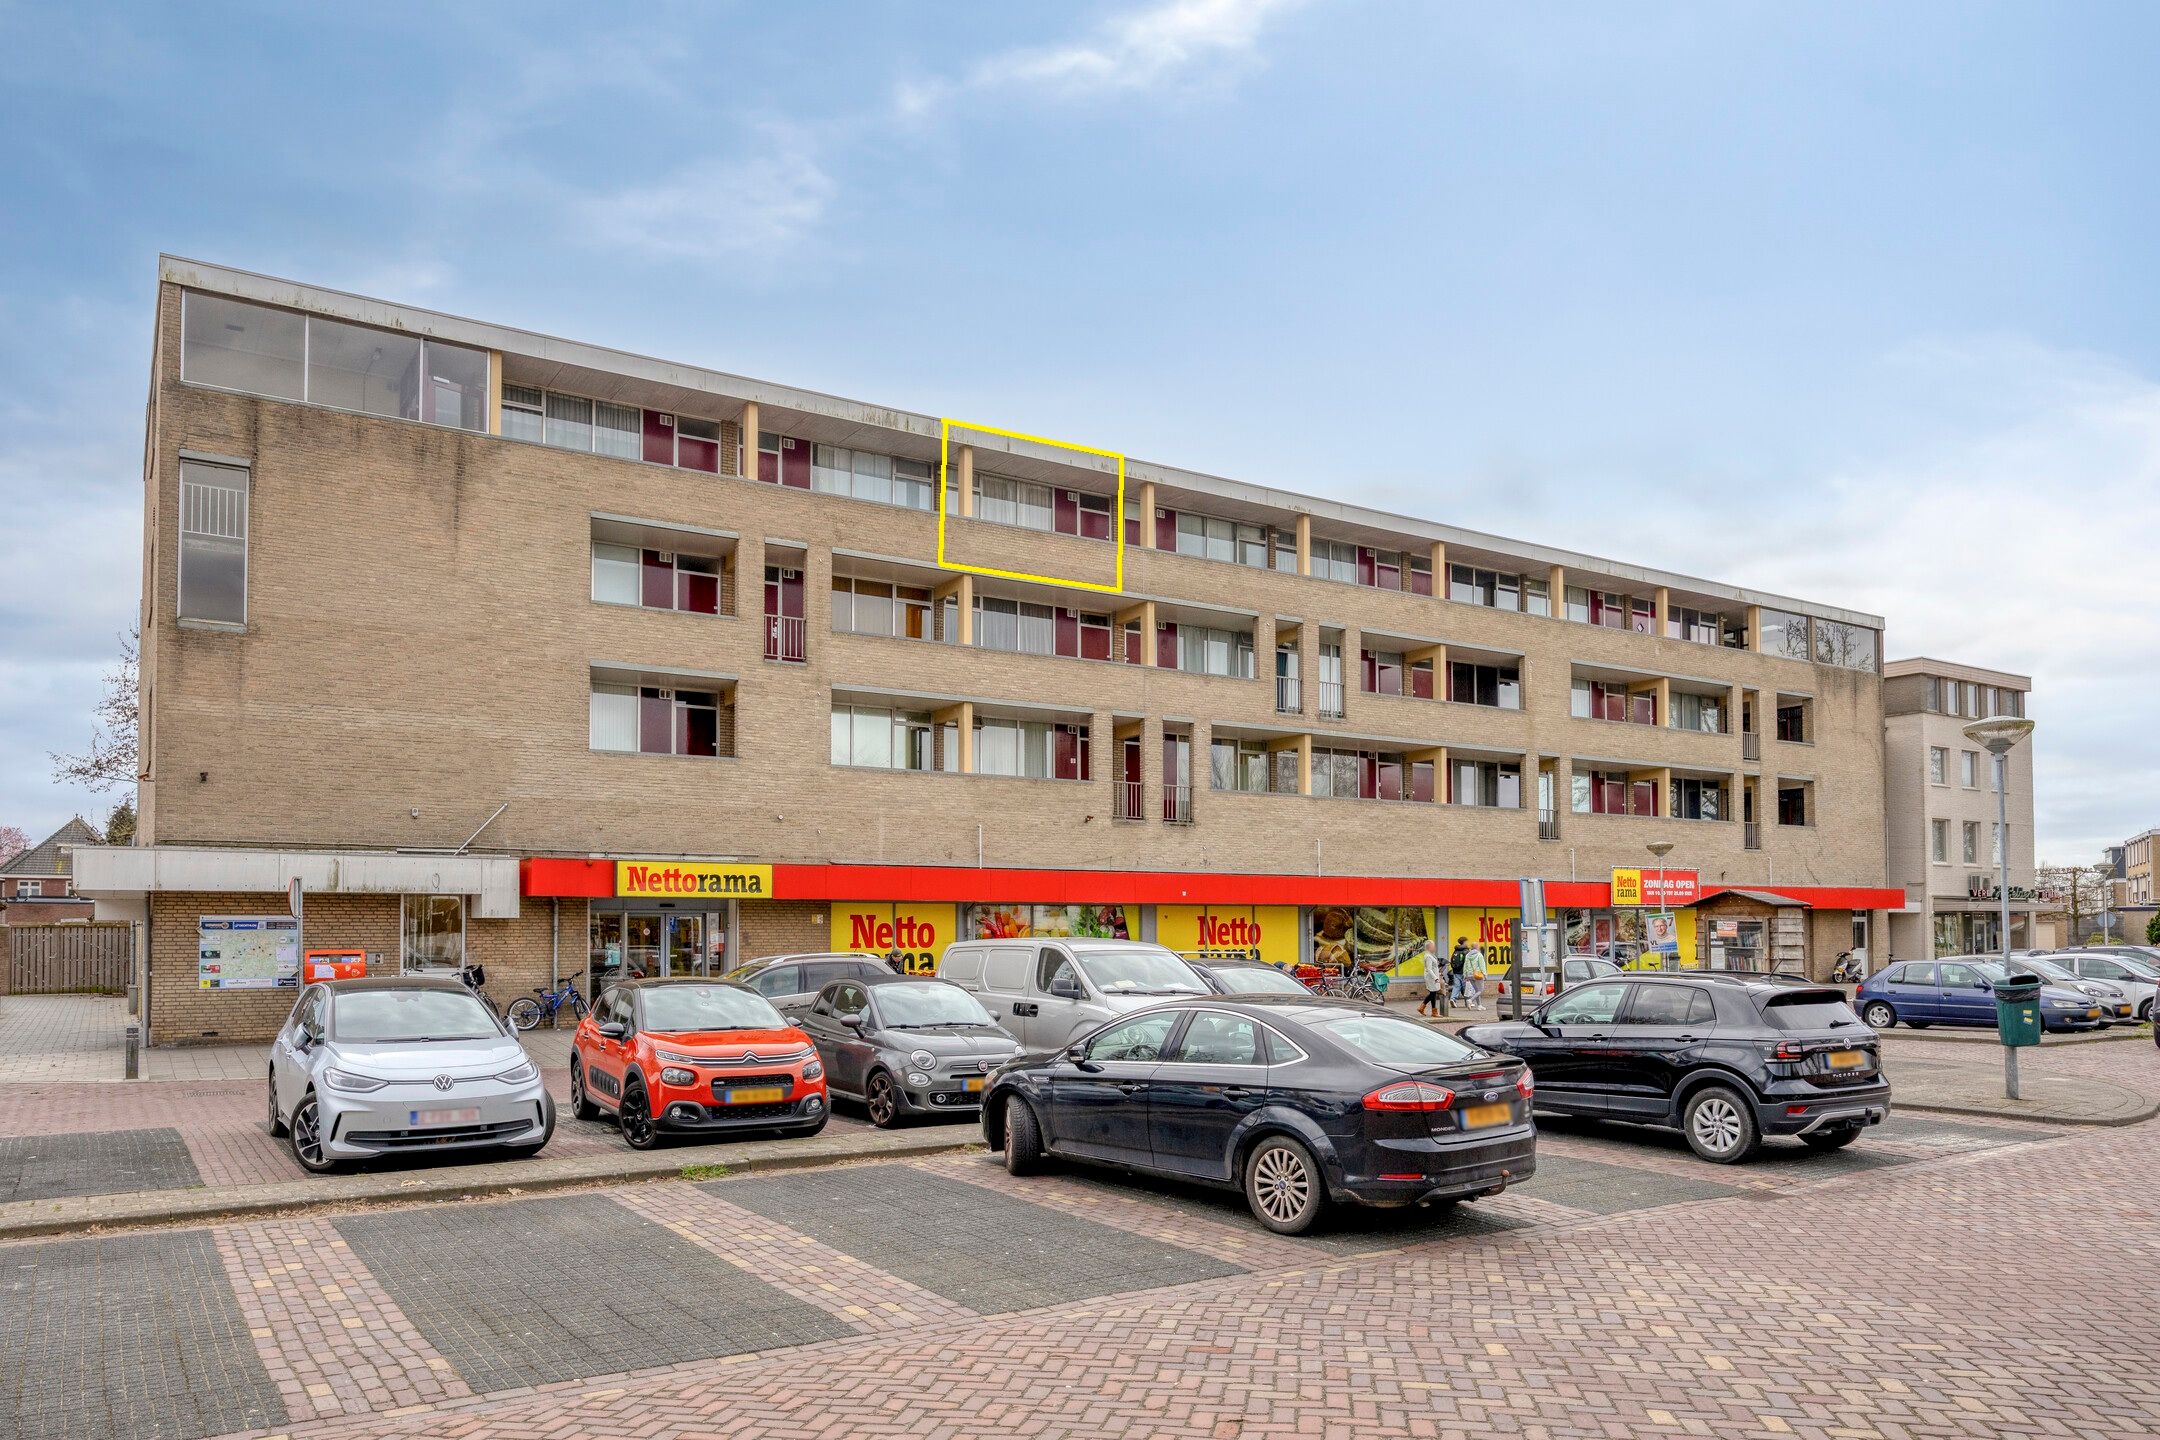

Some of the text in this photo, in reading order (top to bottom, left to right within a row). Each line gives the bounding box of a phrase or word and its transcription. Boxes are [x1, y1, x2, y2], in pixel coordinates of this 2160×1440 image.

[627, 866, 762, 893] Nettorama
[1617, 876, 1637, 888] Netto
[1643, 880, 1695, 889] ZONAG OPEN
[1617, 888, 1637, 898] rama
[850, 914, 935, 948] Netto
[1197, 915, 1261, 945] Netto
[1478, 917, 1511, 942] Net
[1480, 946, 1511, 965] am
